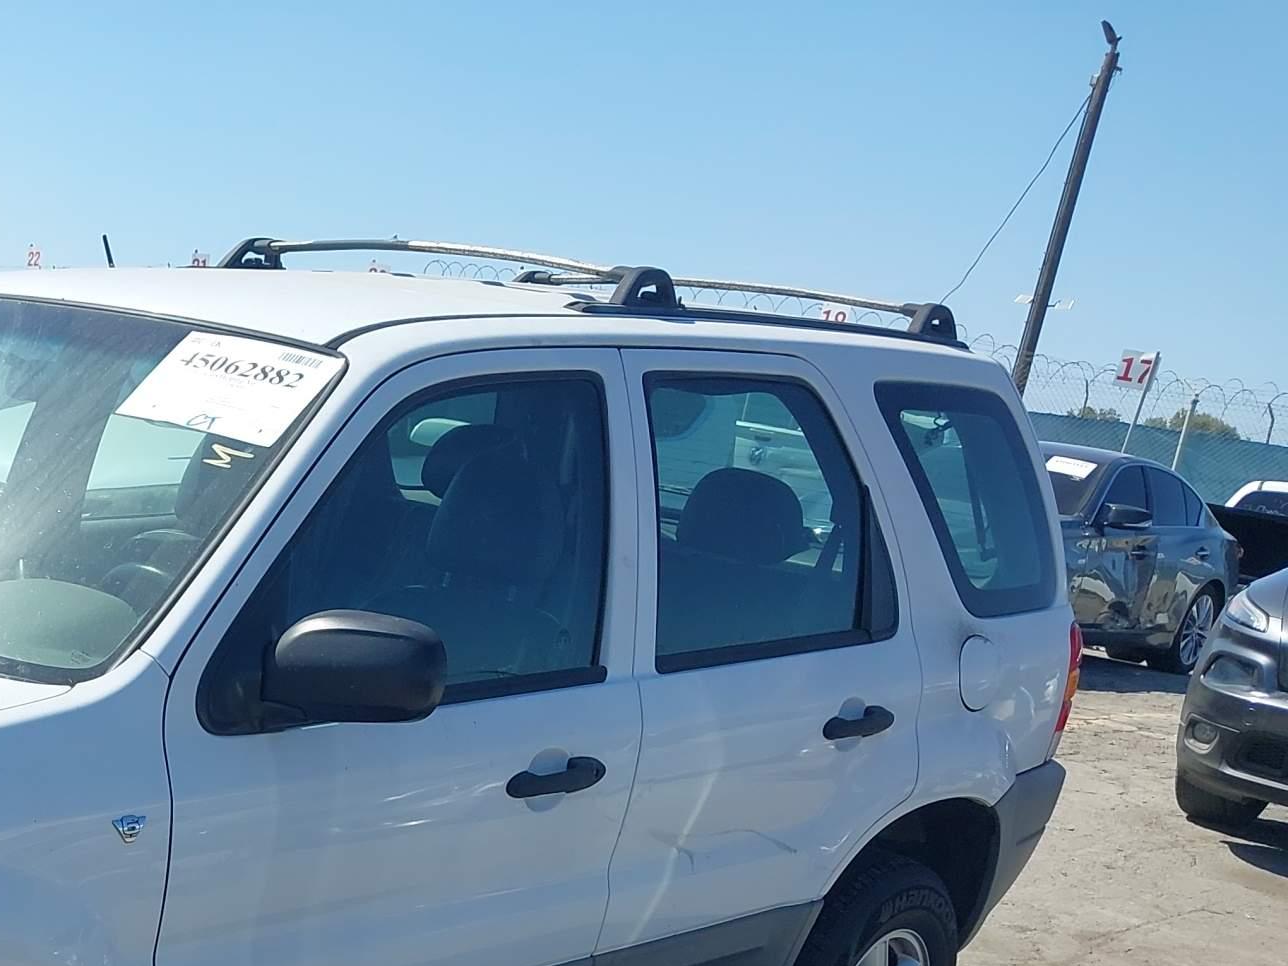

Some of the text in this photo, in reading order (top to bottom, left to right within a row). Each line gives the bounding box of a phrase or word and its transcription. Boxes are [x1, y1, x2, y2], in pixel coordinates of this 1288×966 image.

[27, 251, 41, 267] 22
[179, 351, 305, 389] 45062882
[1116, 357, 1153, 384] 17
